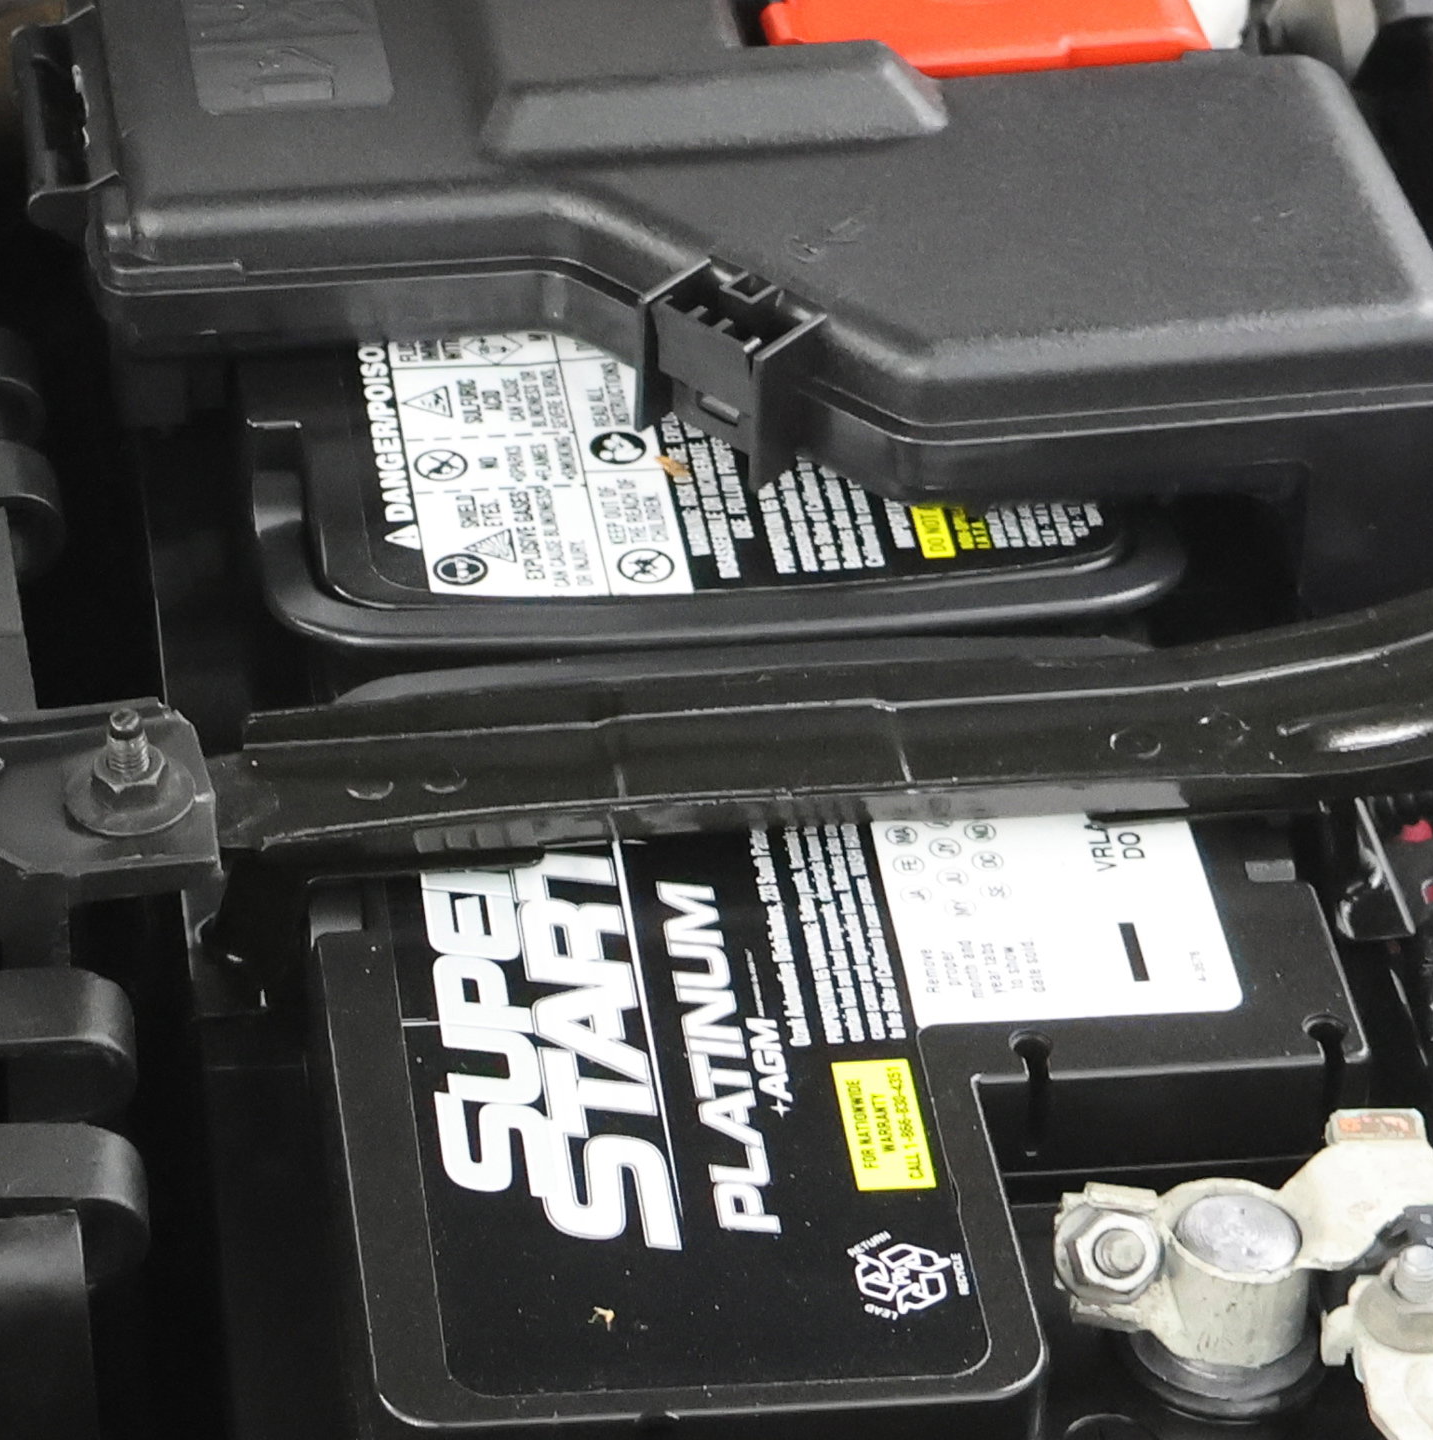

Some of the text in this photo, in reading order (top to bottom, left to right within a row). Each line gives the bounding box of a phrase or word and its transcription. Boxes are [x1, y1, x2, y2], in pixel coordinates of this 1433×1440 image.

[357, 341, 416, 523] DANGER/POISO
[454, 495, 479, 528] SHIELD
[508, 489, 546, 579] EXPLOSIVE GASES
[544, 540, 566, 566] CAUSE
[551, 570, 571, 586] CAN
[920, 949, 940, 992] Remove
[941, 950, 961, 985] proper
[957, 939, 983, 998] month and
[981, 942, 1006, 993] year tabs
[1003, 946, 1023, 988] to show
[1028, 968, 1046, 992] date
[508, 853, 681, 1249] START
[654, 882, 781, 1232] PLATINUM
[845, 1079, 879, 1168] FOR NATIONWIDE
[870, 1092, 895, 1152] WARRANTY
[904, 1153, 924, 1178] CALL
[846, 1230, 891, 1259] RETURN
[950, 1252, 970, 1295] RECYCLE
[863, 1301, 899, 1320] LEAD
